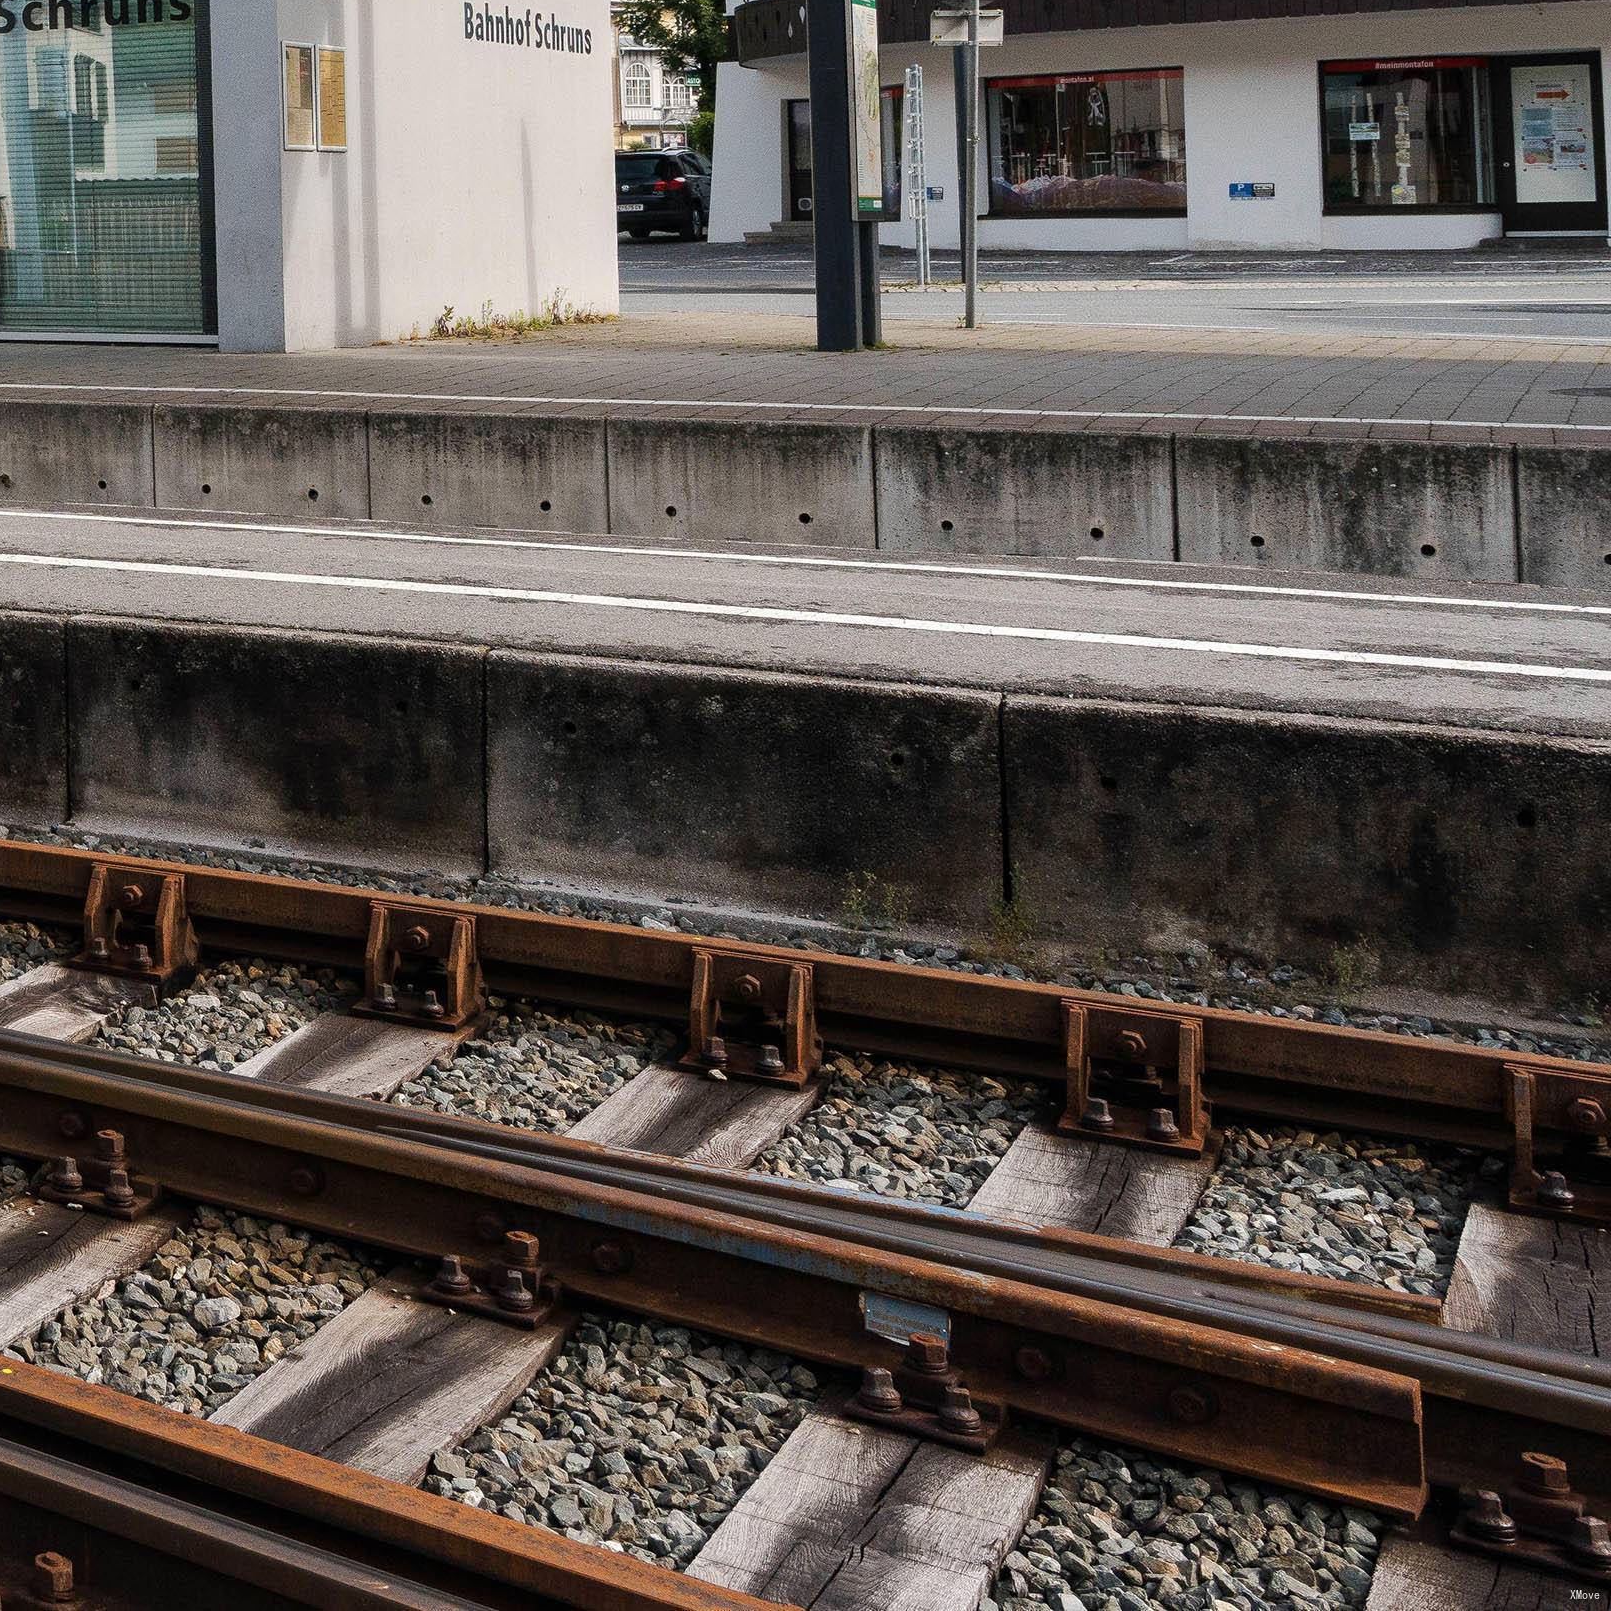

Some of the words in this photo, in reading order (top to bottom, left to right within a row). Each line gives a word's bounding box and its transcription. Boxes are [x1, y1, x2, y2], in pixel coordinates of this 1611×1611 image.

[464, 1, 531, 47] Bahnhof
[534, 12, 592, 55] Schruns
[1374, 61, 1434, 69] #meinmontafon
[1237, 183, 1245, 191] P
